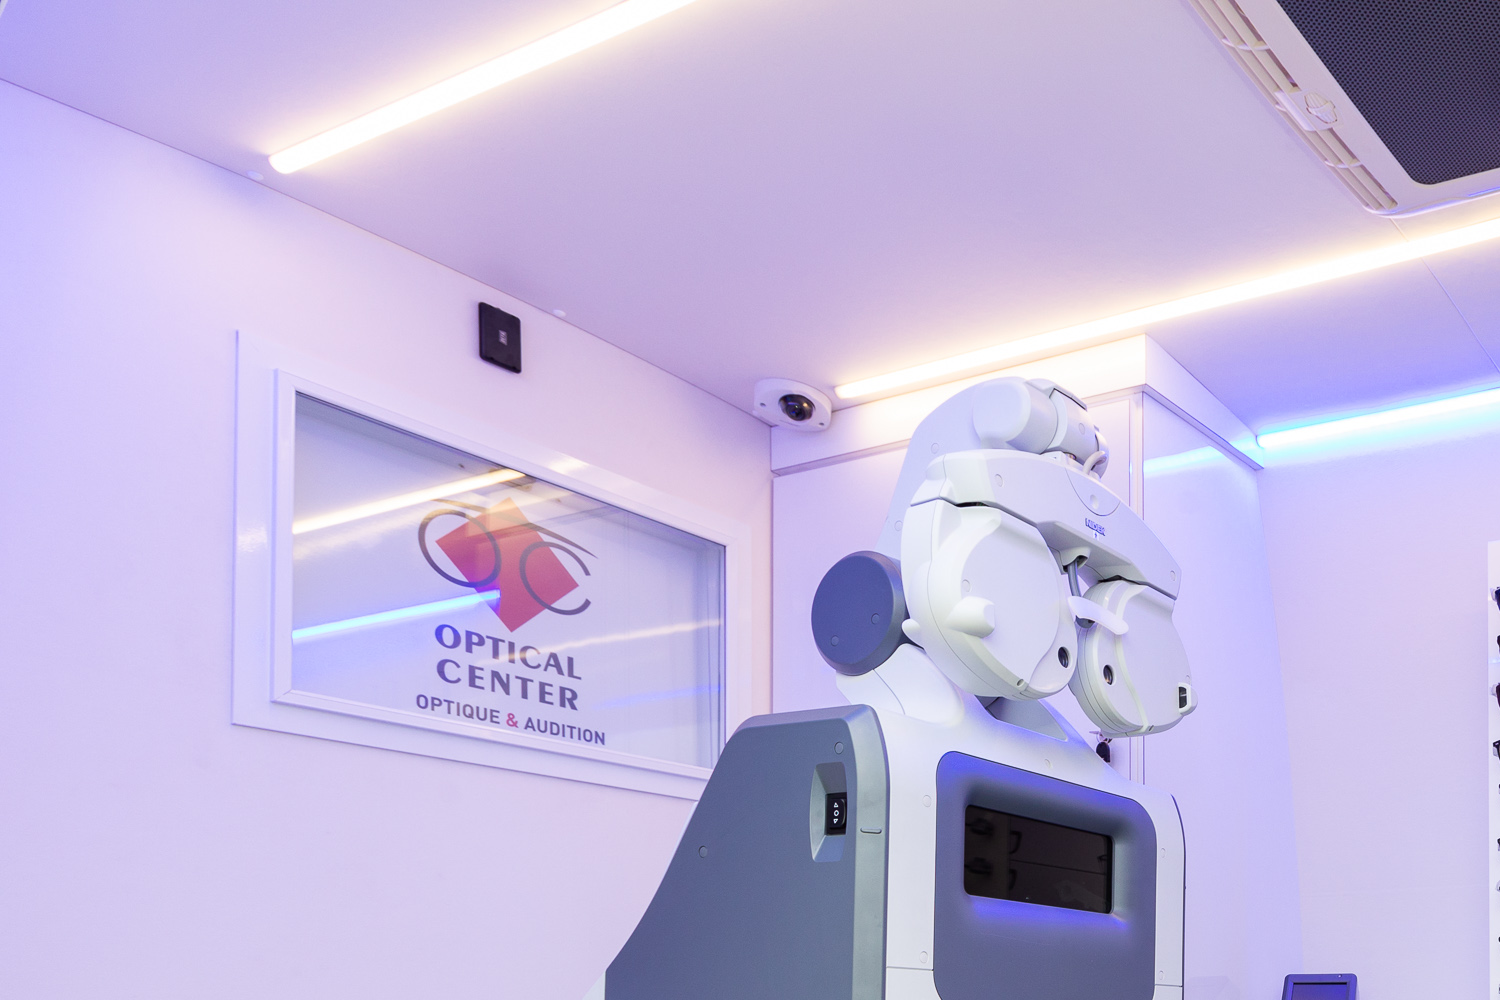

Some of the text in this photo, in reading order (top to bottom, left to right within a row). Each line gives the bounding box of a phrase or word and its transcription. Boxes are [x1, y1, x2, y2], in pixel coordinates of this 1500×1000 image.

[434, 623, 582, 681] OPTICAL
[436, 658, 579, 711] CENTER
[416, 694, 606, 746] OPTIQUE & AUDITION
